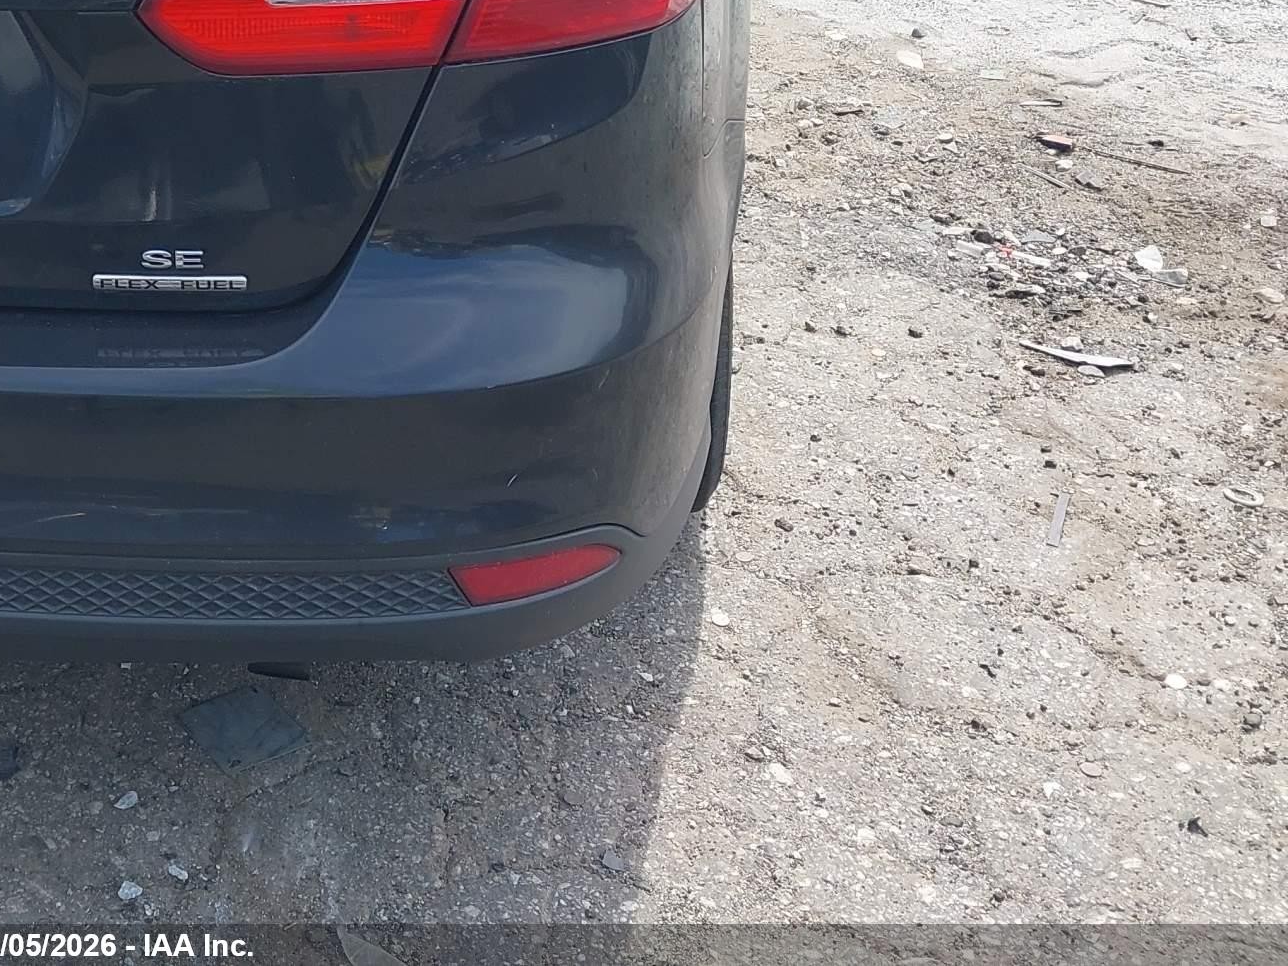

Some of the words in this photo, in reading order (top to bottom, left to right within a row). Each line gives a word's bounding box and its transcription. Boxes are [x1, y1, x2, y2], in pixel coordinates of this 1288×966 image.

[141, 250, 204, 269] SE
[100, 279, 159, 290] FLEX
[181, 280, 242, 290] FUEL
